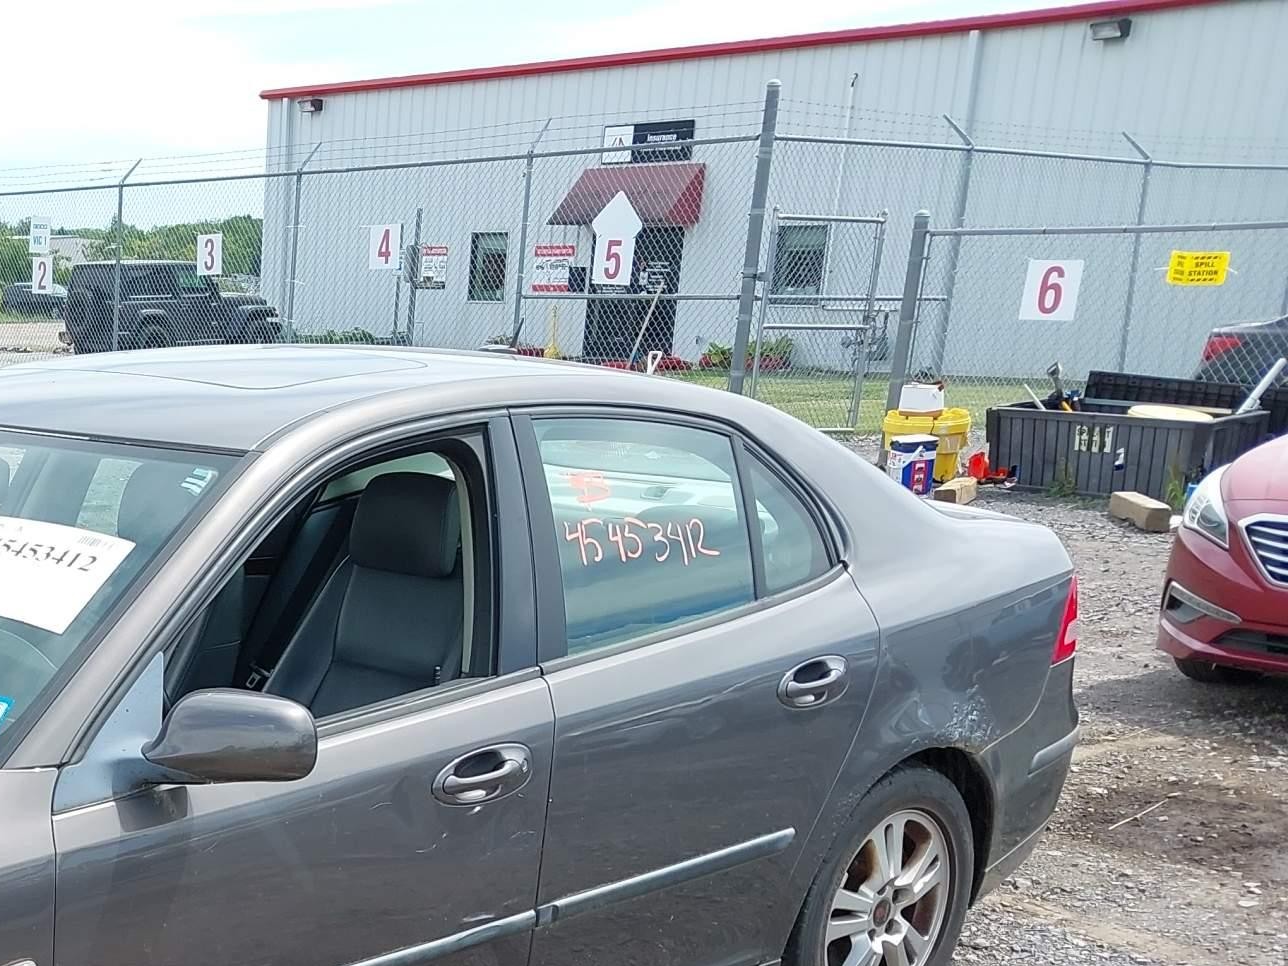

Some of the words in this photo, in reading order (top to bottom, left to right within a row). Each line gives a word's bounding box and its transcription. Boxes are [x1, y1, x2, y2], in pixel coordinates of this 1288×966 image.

[204, 238, 215, 271] 3
[377, 229, 391, 265] 4
[604, 239, 623, 280] 5
[38, 261, 47, 290] 2
[1038, 265, 1065, 314] 6
[1187, 269, 1218, 277] STATION
